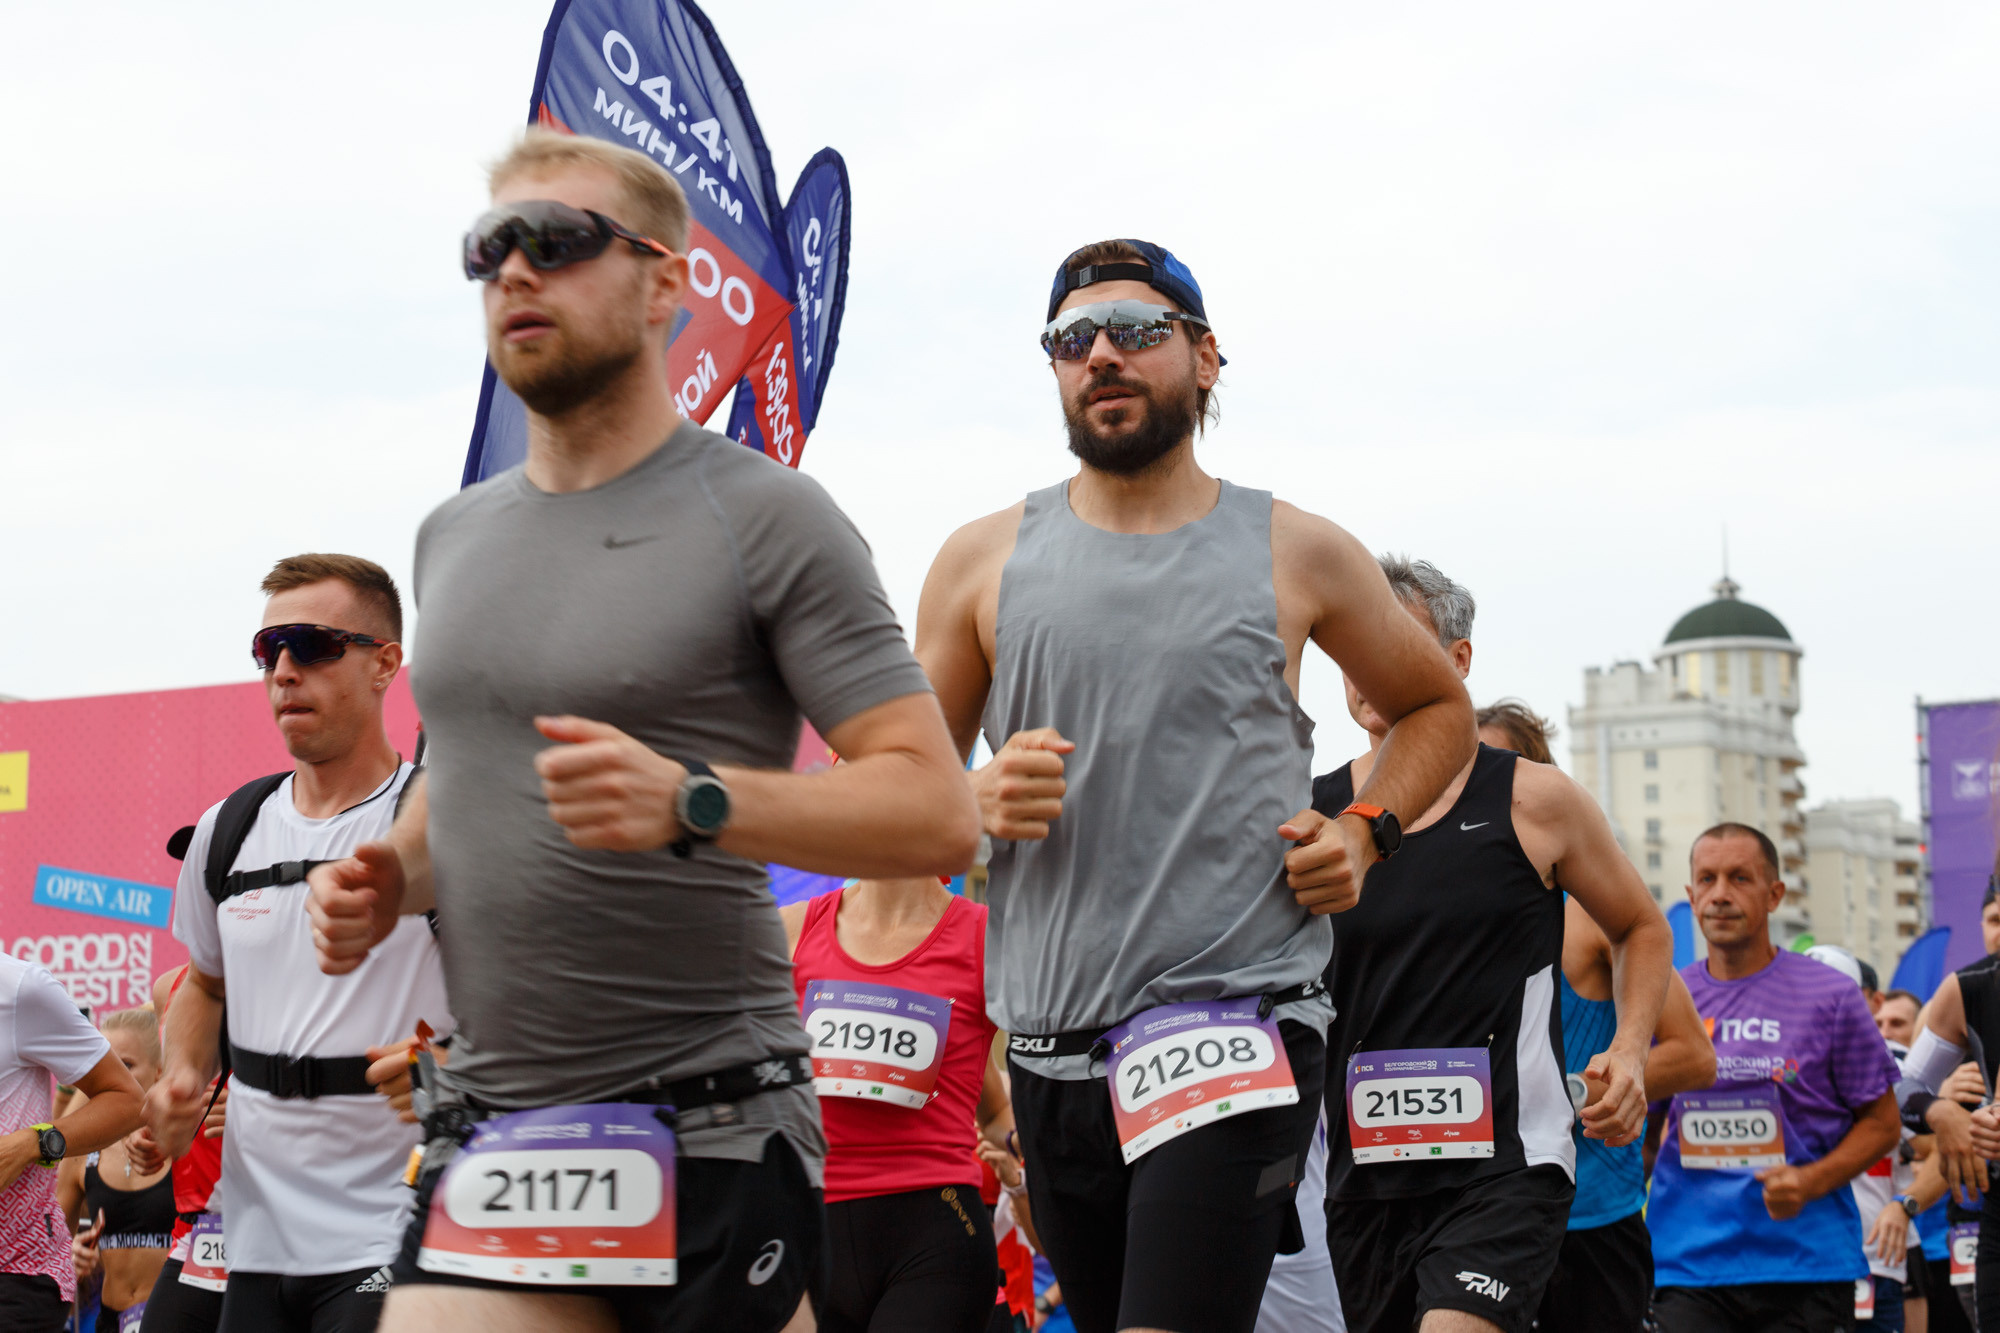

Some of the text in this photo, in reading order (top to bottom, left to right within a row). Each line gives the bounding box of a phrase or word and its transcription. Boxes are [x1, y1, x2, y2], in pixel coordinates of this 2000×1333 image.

[602, 29, 741, 183] 04:41
[46, 873, 152, 917] OPEN AIR
[127, 932, 152, 1005] 2022
[818, 1020, 917, 1059] 21918
[1010, 1036, 1056, 1053] 2XU
[1721, 1017, 1781, 1042] ПСБ
[1126, 1037, 1257, 1100] 21208
[1366, 1088, 1462, 1118] 21531
[1690, 1118, 1767, 1138] 10350
[482, 1169, 619, 1211] 21171
